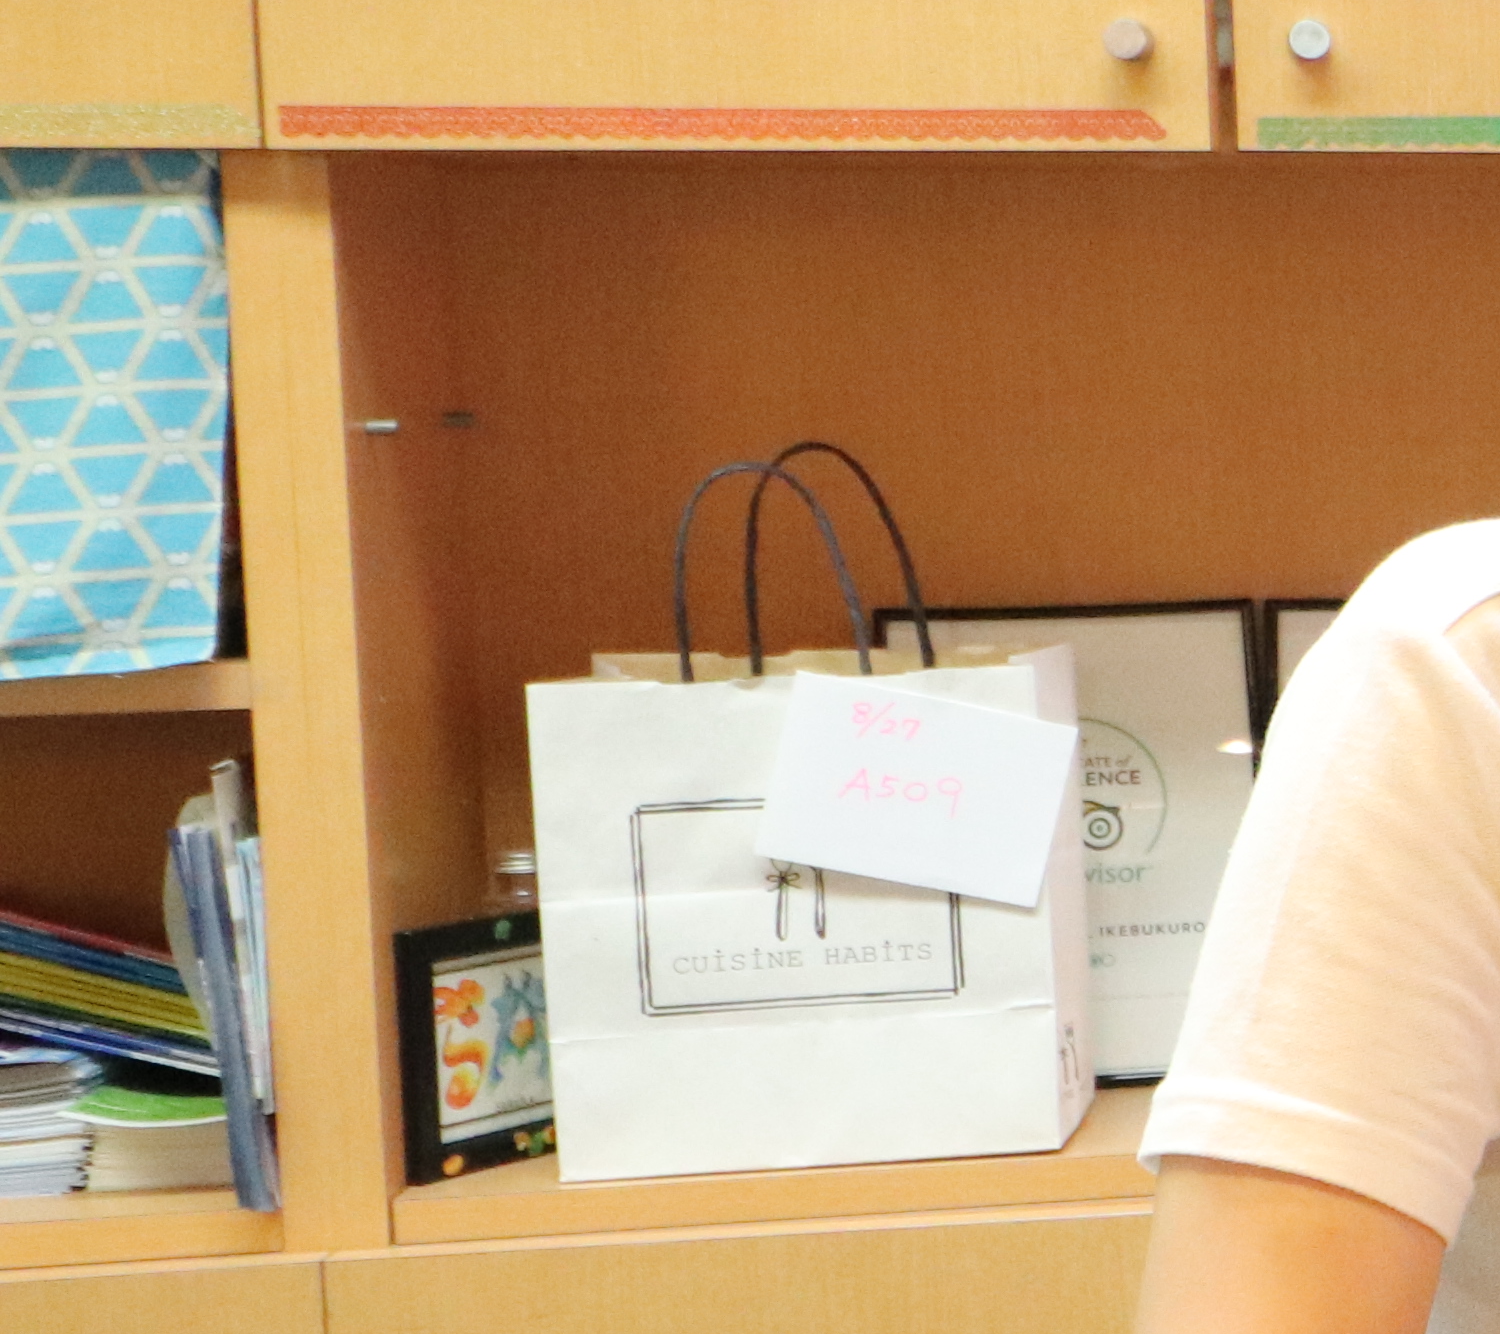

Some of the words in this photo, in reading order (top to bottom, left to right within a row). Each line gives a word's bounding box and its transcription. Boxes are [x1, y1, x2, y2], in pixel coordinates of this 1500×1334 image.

[1082, 770, 1142, 786] ENCE
[838, 768, 963, 818] A509
[1099, 922, 1206, 937] IKEBUKURO
